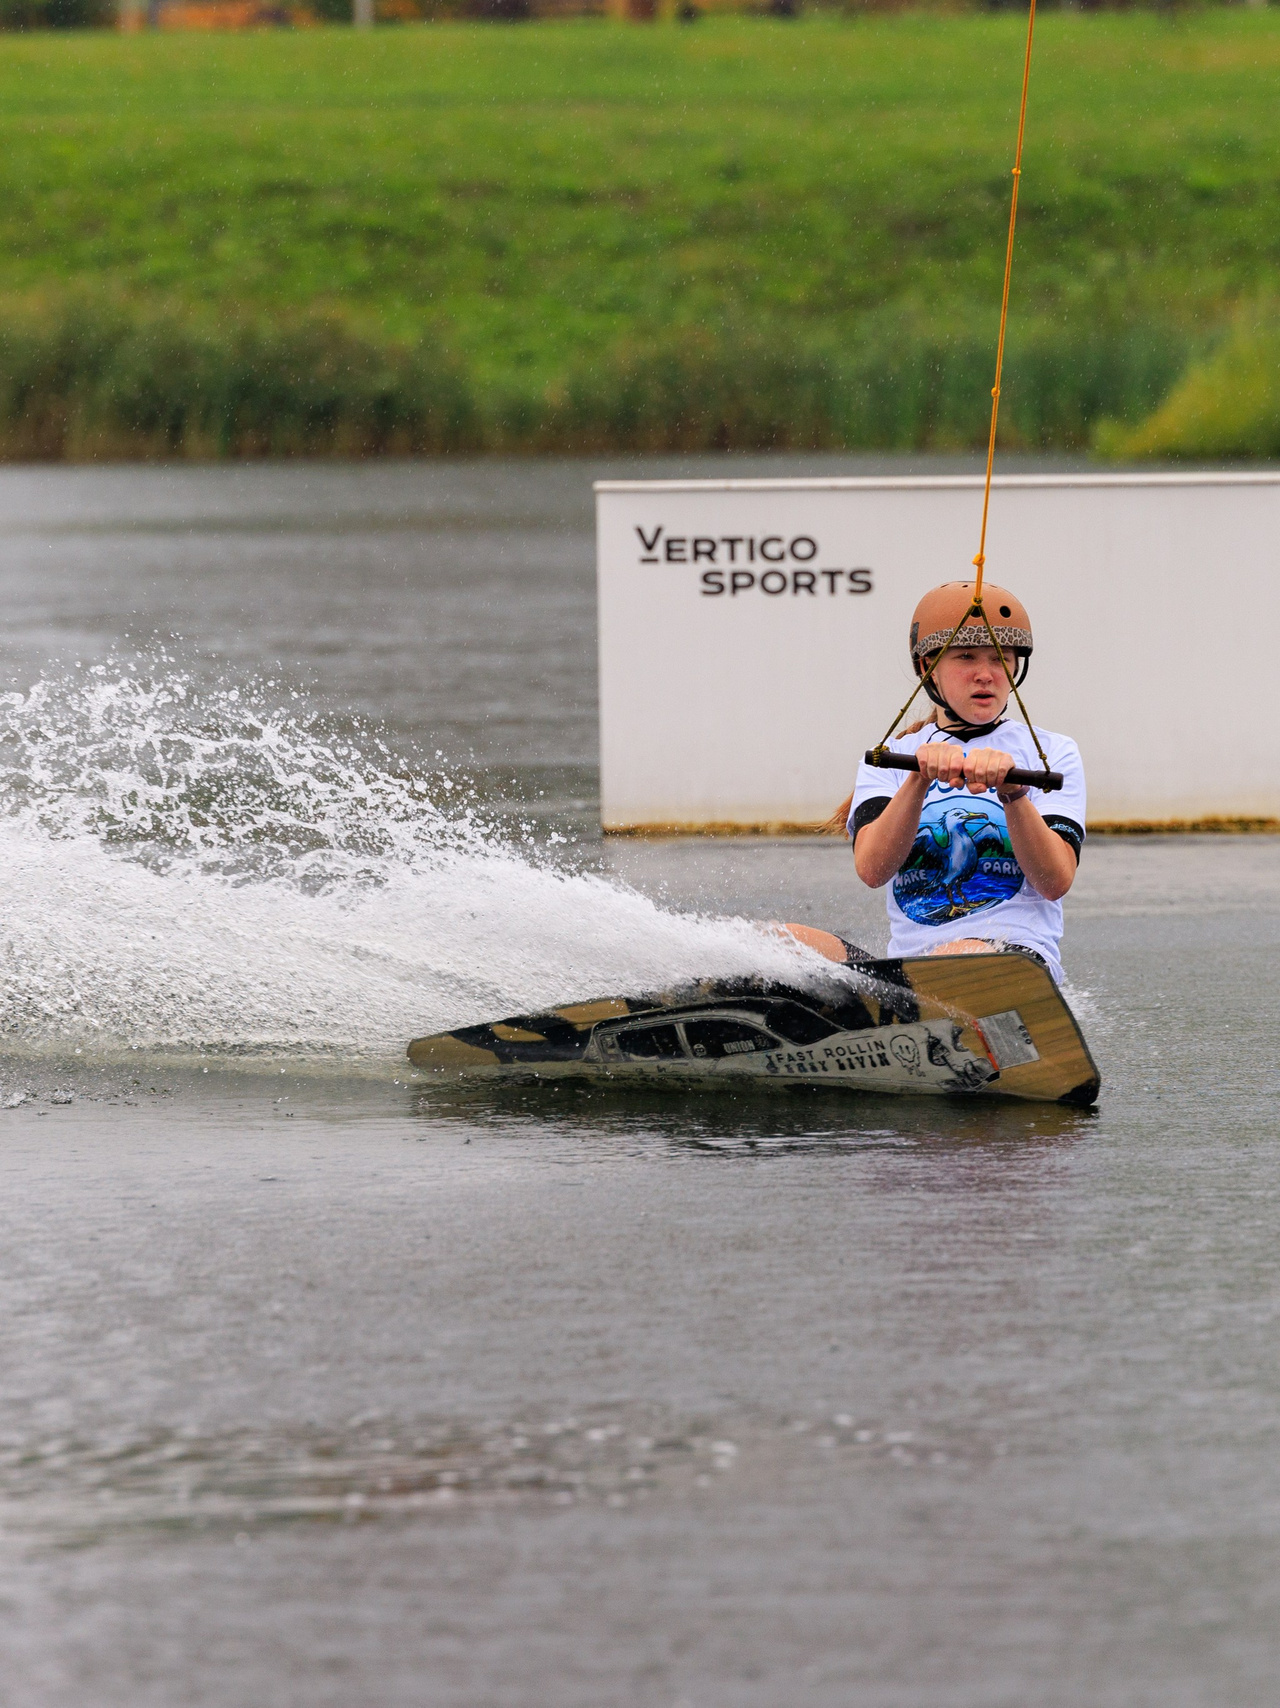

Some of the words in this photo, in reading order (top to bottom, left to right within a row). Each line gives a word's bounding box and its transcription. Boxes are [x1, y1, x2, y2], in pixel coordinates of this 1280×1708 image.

[635, 525, 818, 563] VERTIGO
[702, 569, 873, 596] SPORTS
[895, 869, 928, 887] WAKE
[722, 1039, 756, 1054] UNION
[775, 1050, 814, 1063] FAST
[823, 1040, 886, 1059] ROLLIN
[835, 1052, 891, 1071] LIVIN
